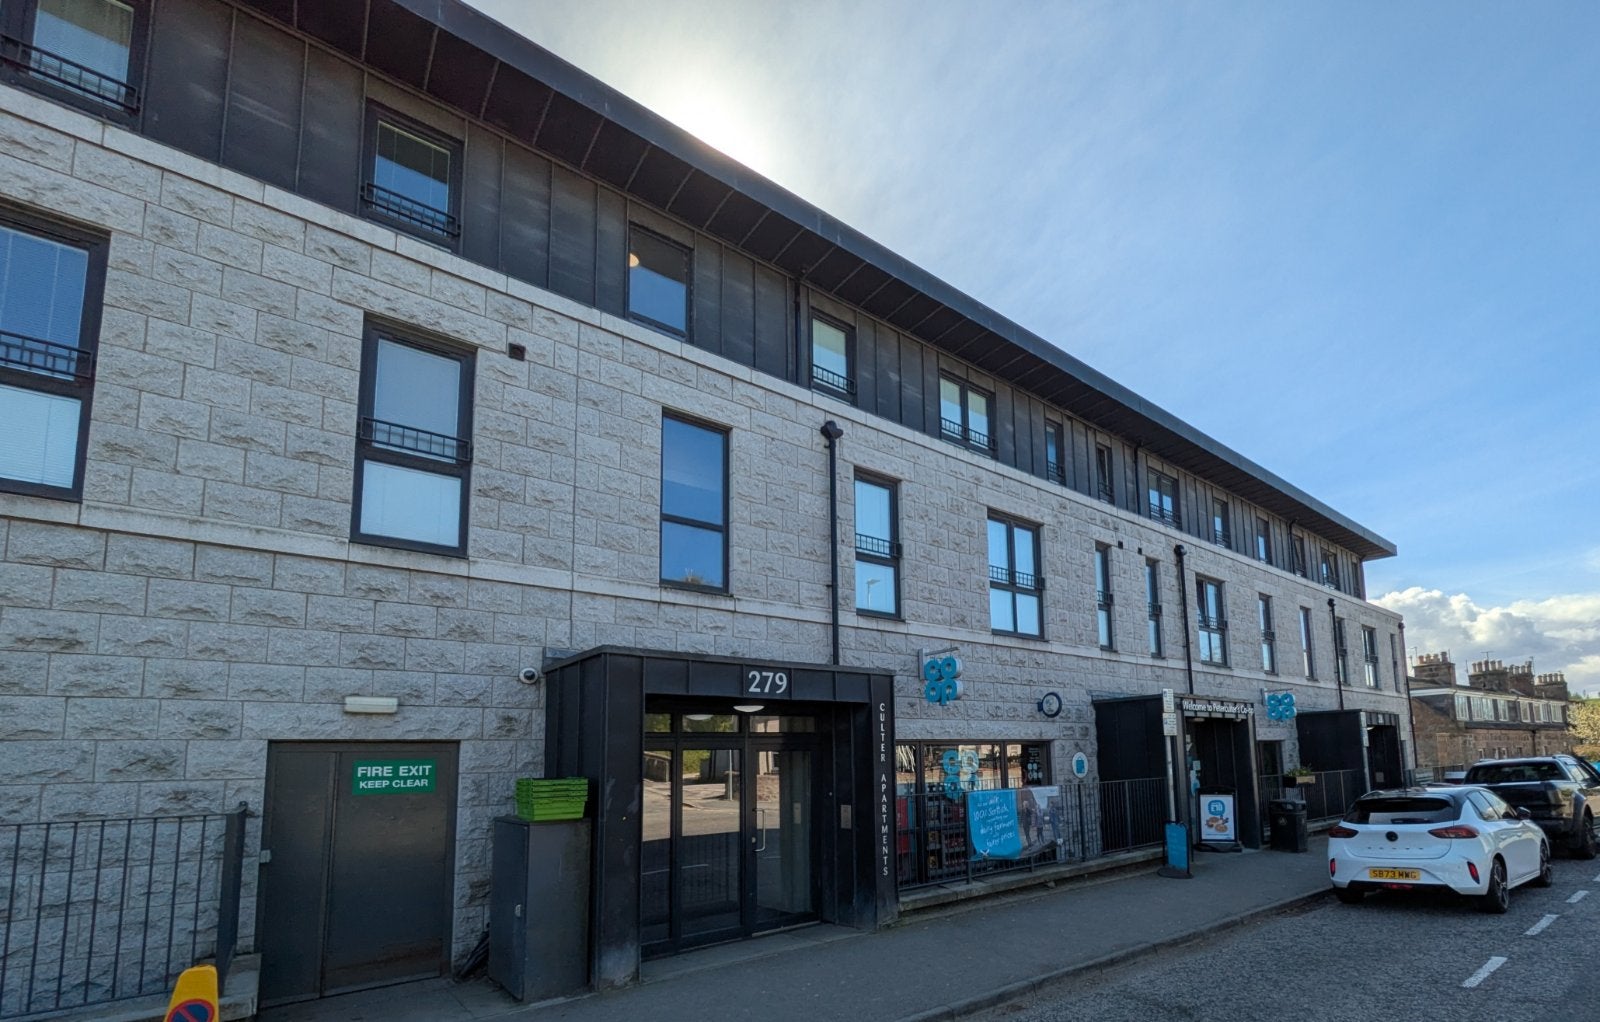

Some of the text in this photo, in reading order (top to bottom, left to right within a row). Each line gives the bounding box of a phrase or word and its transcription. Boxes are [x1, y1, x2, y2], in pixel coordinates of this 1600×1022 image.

[748, 670, 788, 694] 279
[1182, 699, 1206, 712] Welcome
[1206, 703, 1213, 712] to
[357, 765, 432, 777] FIRE EXIT
[359, 779, 428, 789] KEEP CLEAR
[880, 773, 889, 876] APARTMENTS
[1372, 869, 1396, 879] SB73
